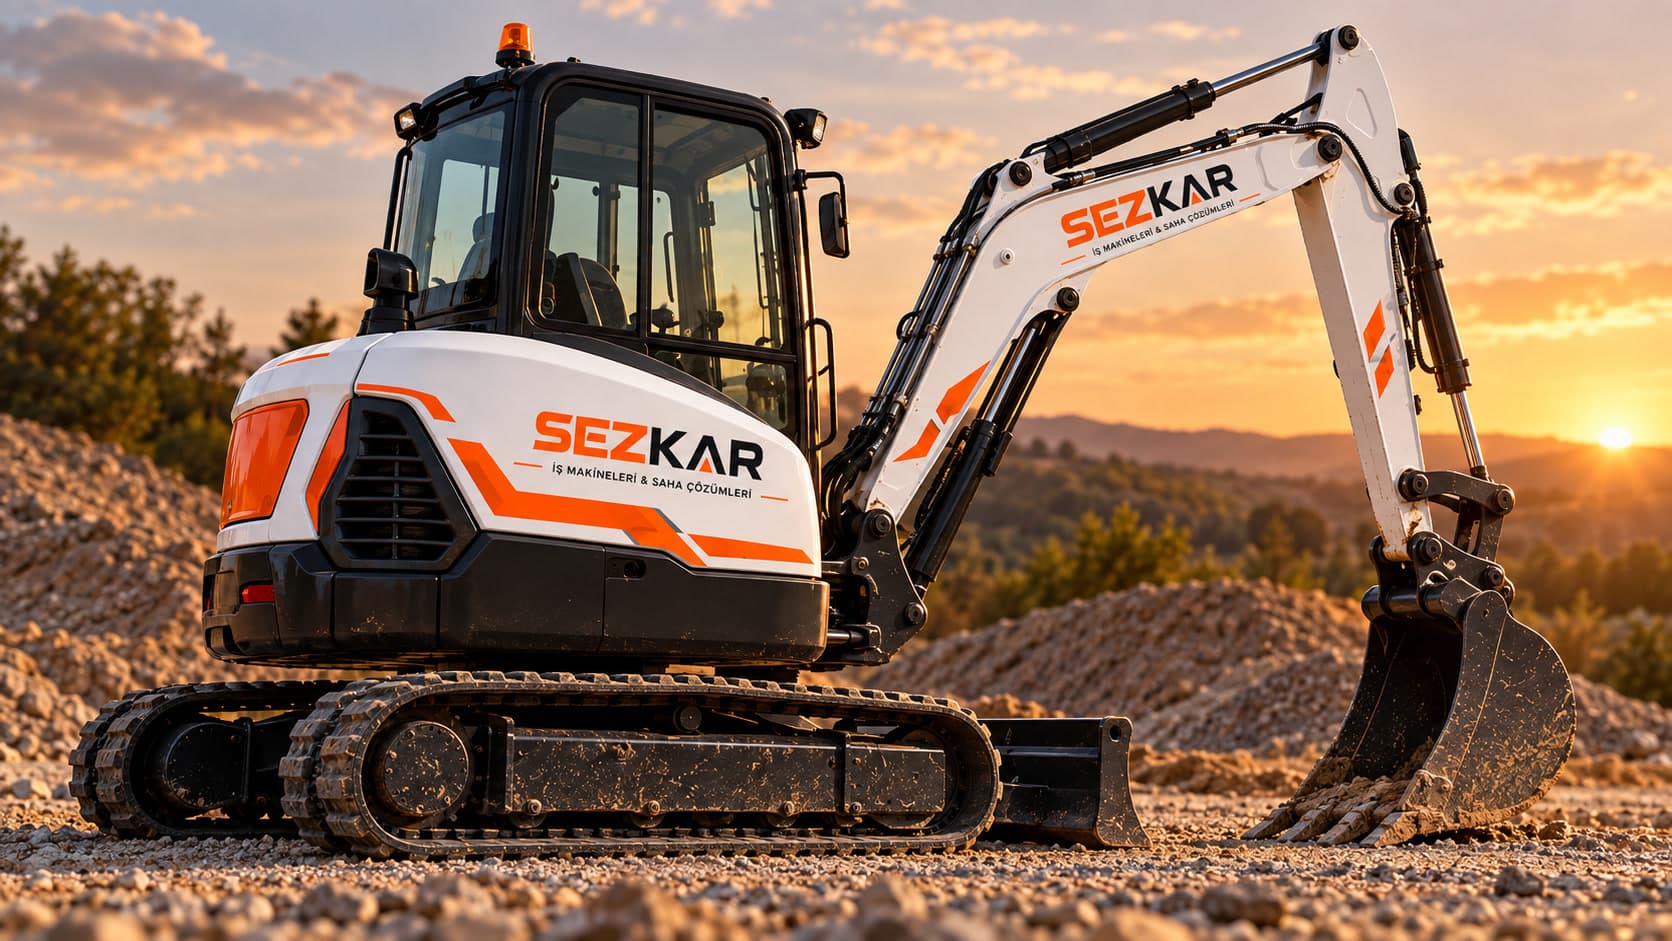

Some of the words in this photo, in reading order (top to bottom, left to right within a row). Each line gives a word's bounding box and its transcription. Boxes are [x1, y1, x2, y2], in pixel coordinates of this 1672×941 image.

[1060, 163, 1238, 249] SEZKAR
[1155, 226, 1162, 234] &
[1162, 217, 1186, 231] SAHA
[533, 410, 763, 480] SEZKAR
[552, 461, 563, 475] İŞ
[567, 466, 637, 484] MAKİNELERİ
[640, 475, 648, 486] &
[652, 477, 683, 490] SAHA
[686, 481, 752, 499] ÇÖZÜMLERİ
